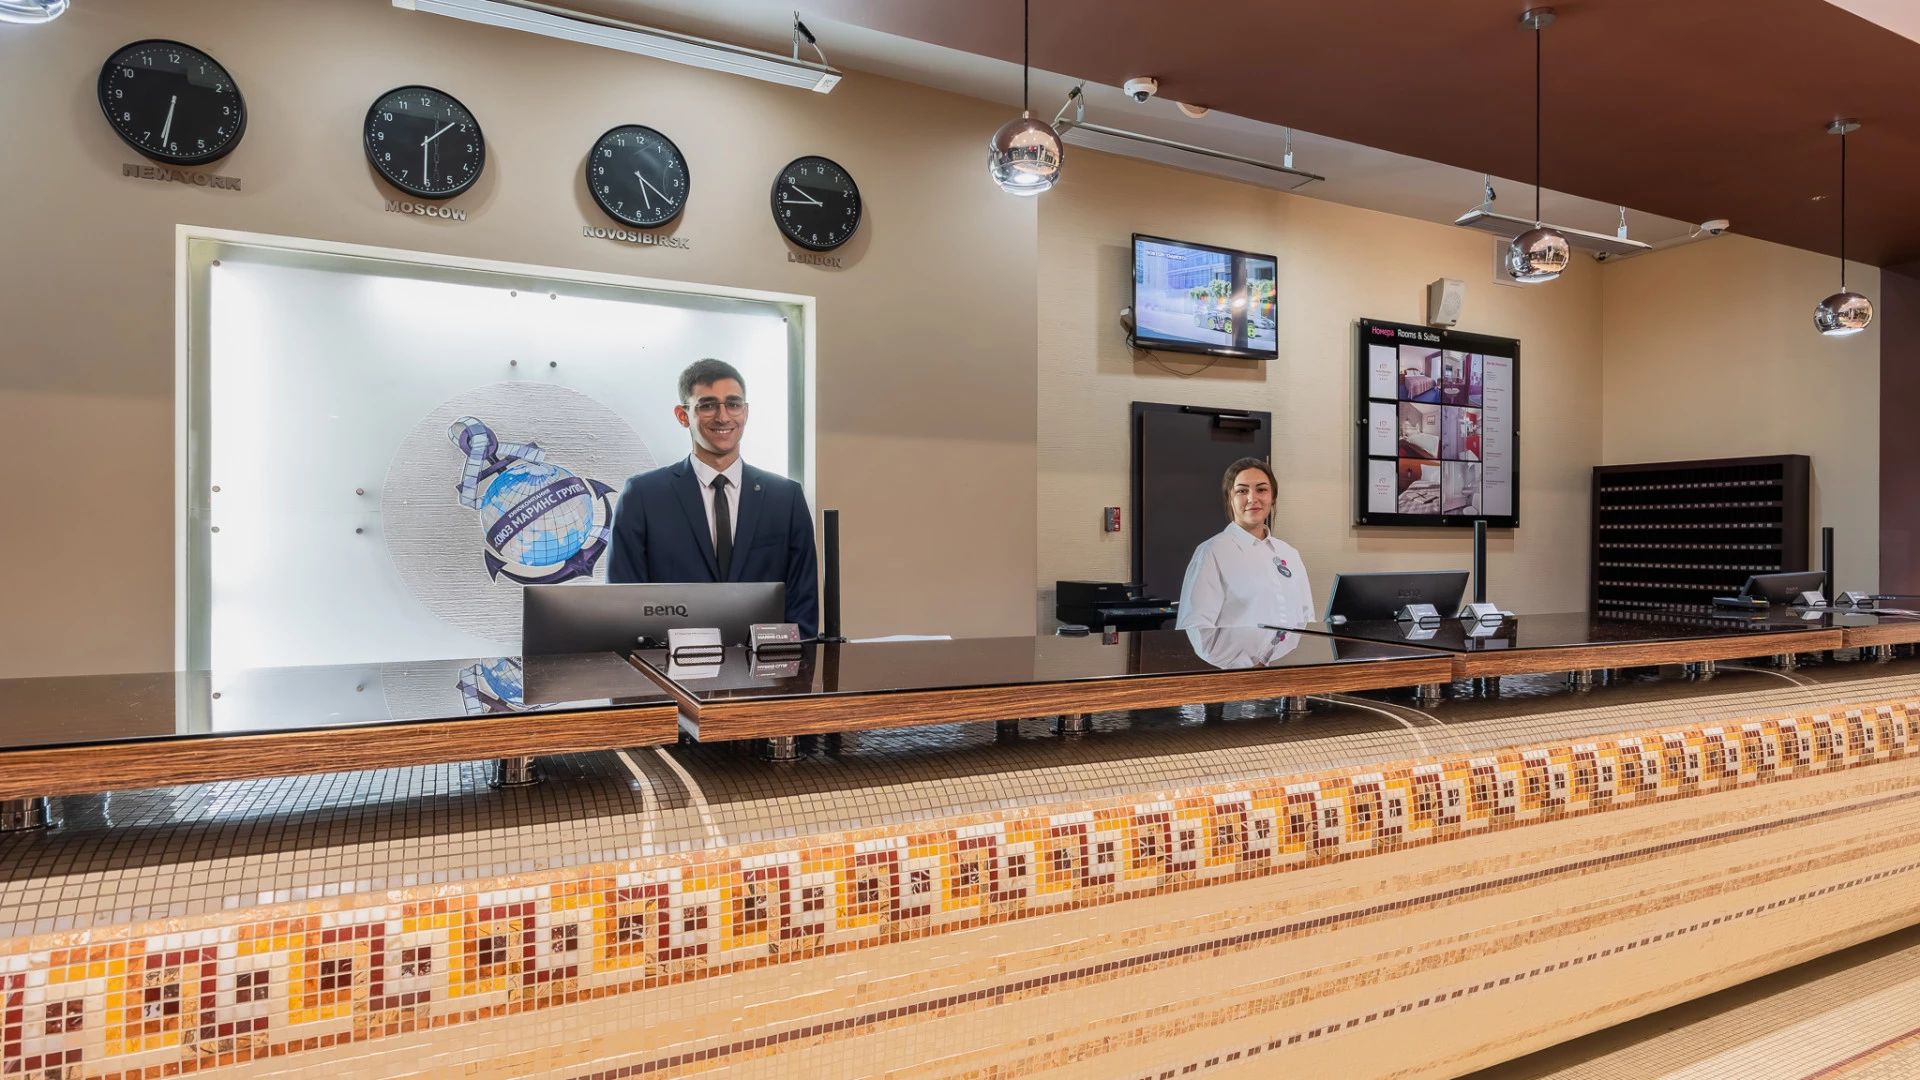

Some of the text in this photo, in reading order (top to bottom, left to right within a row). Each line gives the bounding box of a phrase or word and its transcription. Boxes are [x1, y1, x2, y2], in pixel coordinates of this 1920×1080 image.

[142, 56, 152, 66] 11
[169, 53, 180, 64] 12
[122, 68, 134, 79] 10
[199, 66, 204, 75] 1
[215, 84, 222, 93] 2
[115, 90, 123, 99] 9
[399, 101, 408, 110] 11
[421, 98, 431, 107] 12
[223, 107, 230, 116] 3
[446, 108, 451, 116] 1
[124, 112, 131, 121] 8
[383, 113, 393, 122] 10
[217, 126, 224, 135] 4
[460, 124, 466, 133] 2
[144, 131, 151, 141] 7
[378, 132, 384, 140] 9
[636, 136, 645, 145] 12
[170, 142, 178, 151] 6
[198, 140, 205, 149] 5
[618, 139, 625, 147] 11
[467, 144, 473, 153] 3
[385, 153, 391, 161] 8
[604, 149, 612, 158] 10
[463, 163, 468, 171] 4
[668, 160, 674, 168] 2
[402, 170, 408, 178] 7
[599, 167, 604, 175] 9
[801, 168, 807, 176] 11
[817, 167, 824, 175] 12
[447, 176, 453, 184] 5
[788, 177, 795, 185] 10
[783, 192, 788, 200] 9
[843, 190, 848, 198] 2
[385, 200, 468, 221] MOSCOW
[636, 210, 641, 218] 6
[583, 226, 690, 249] NOVOSIBIRSK
[829, 232, 834, 240] 5
[788, 252, 842, 268] LONDON
[1398, 329, 1416, 339] Rooms
[1417, 331, 1422, 340] &
[1424, 332, 1440, 342] Suites
[511, 494, 557, 528] МАРИНС
[643, 605, 689, 617] BenQ
